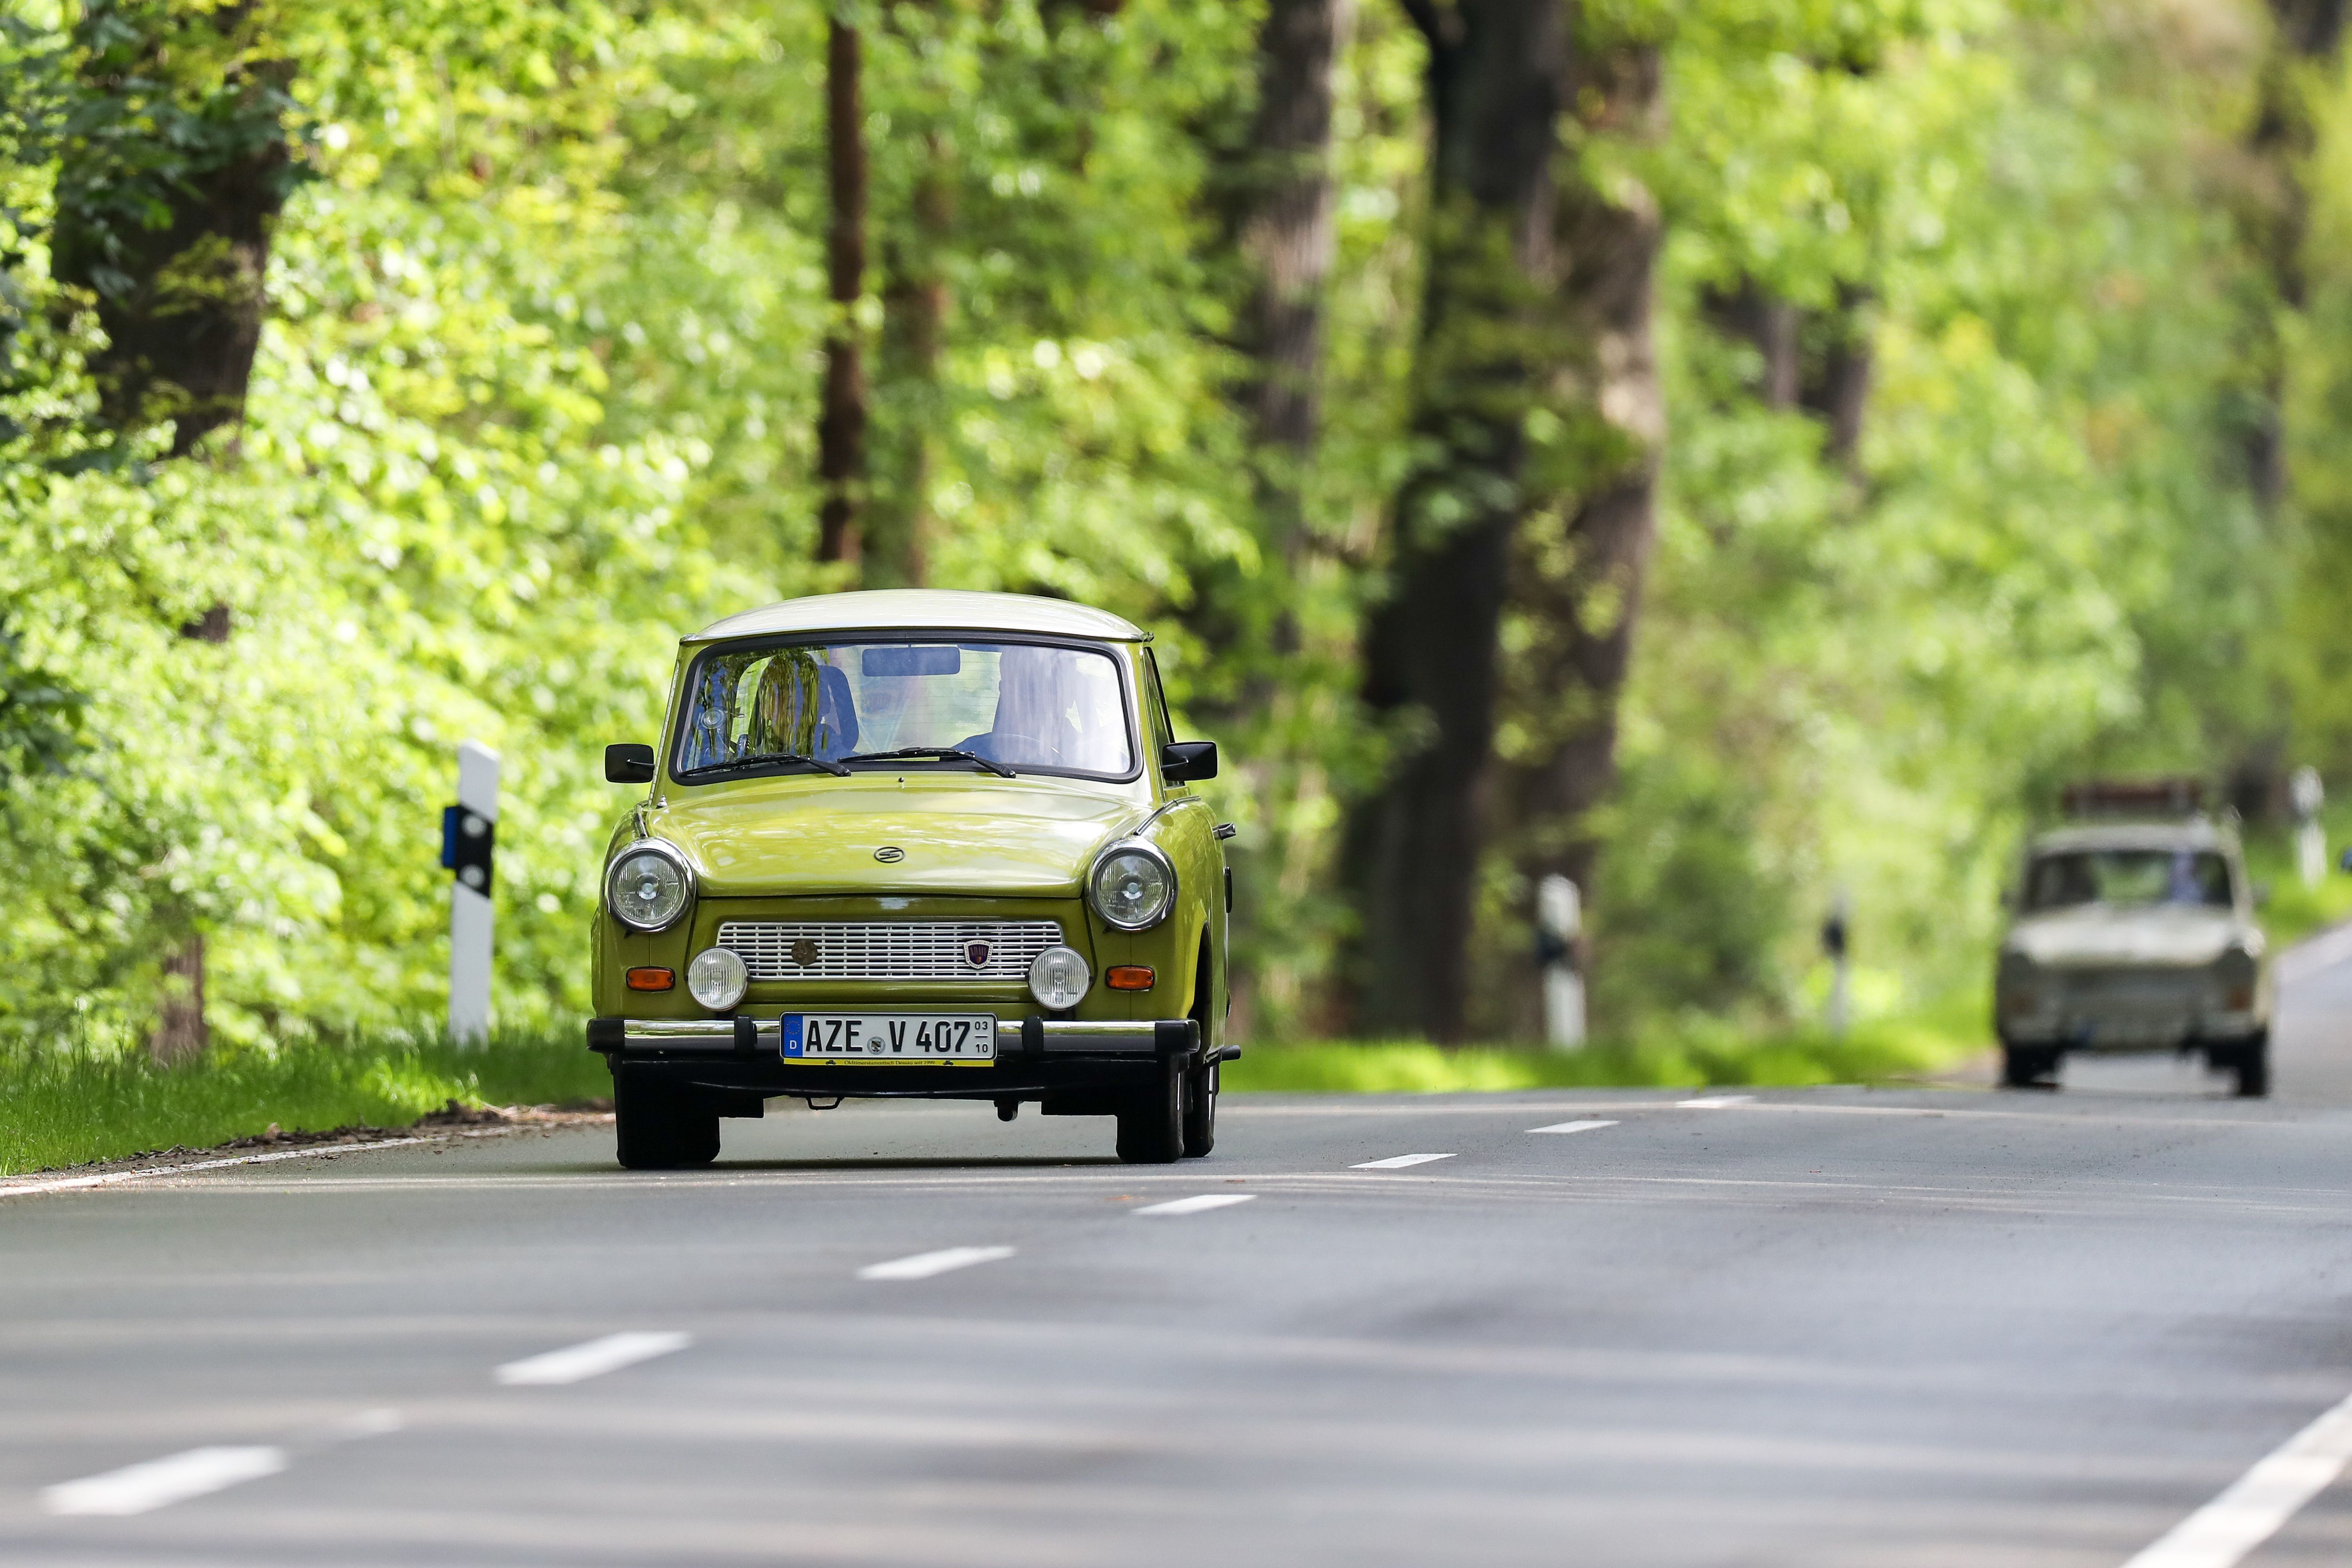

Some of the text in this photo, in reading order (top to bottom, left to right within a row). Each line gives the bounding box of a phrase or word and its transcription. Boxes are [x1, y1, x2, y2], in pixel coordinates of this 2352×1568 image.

[975, 1021, 988, 1030] 03
[806, 1020, 970, 1052] AZE V 407
[790, 1040, 797, 1049] D
[976, 1043, 988, 1052] 10
